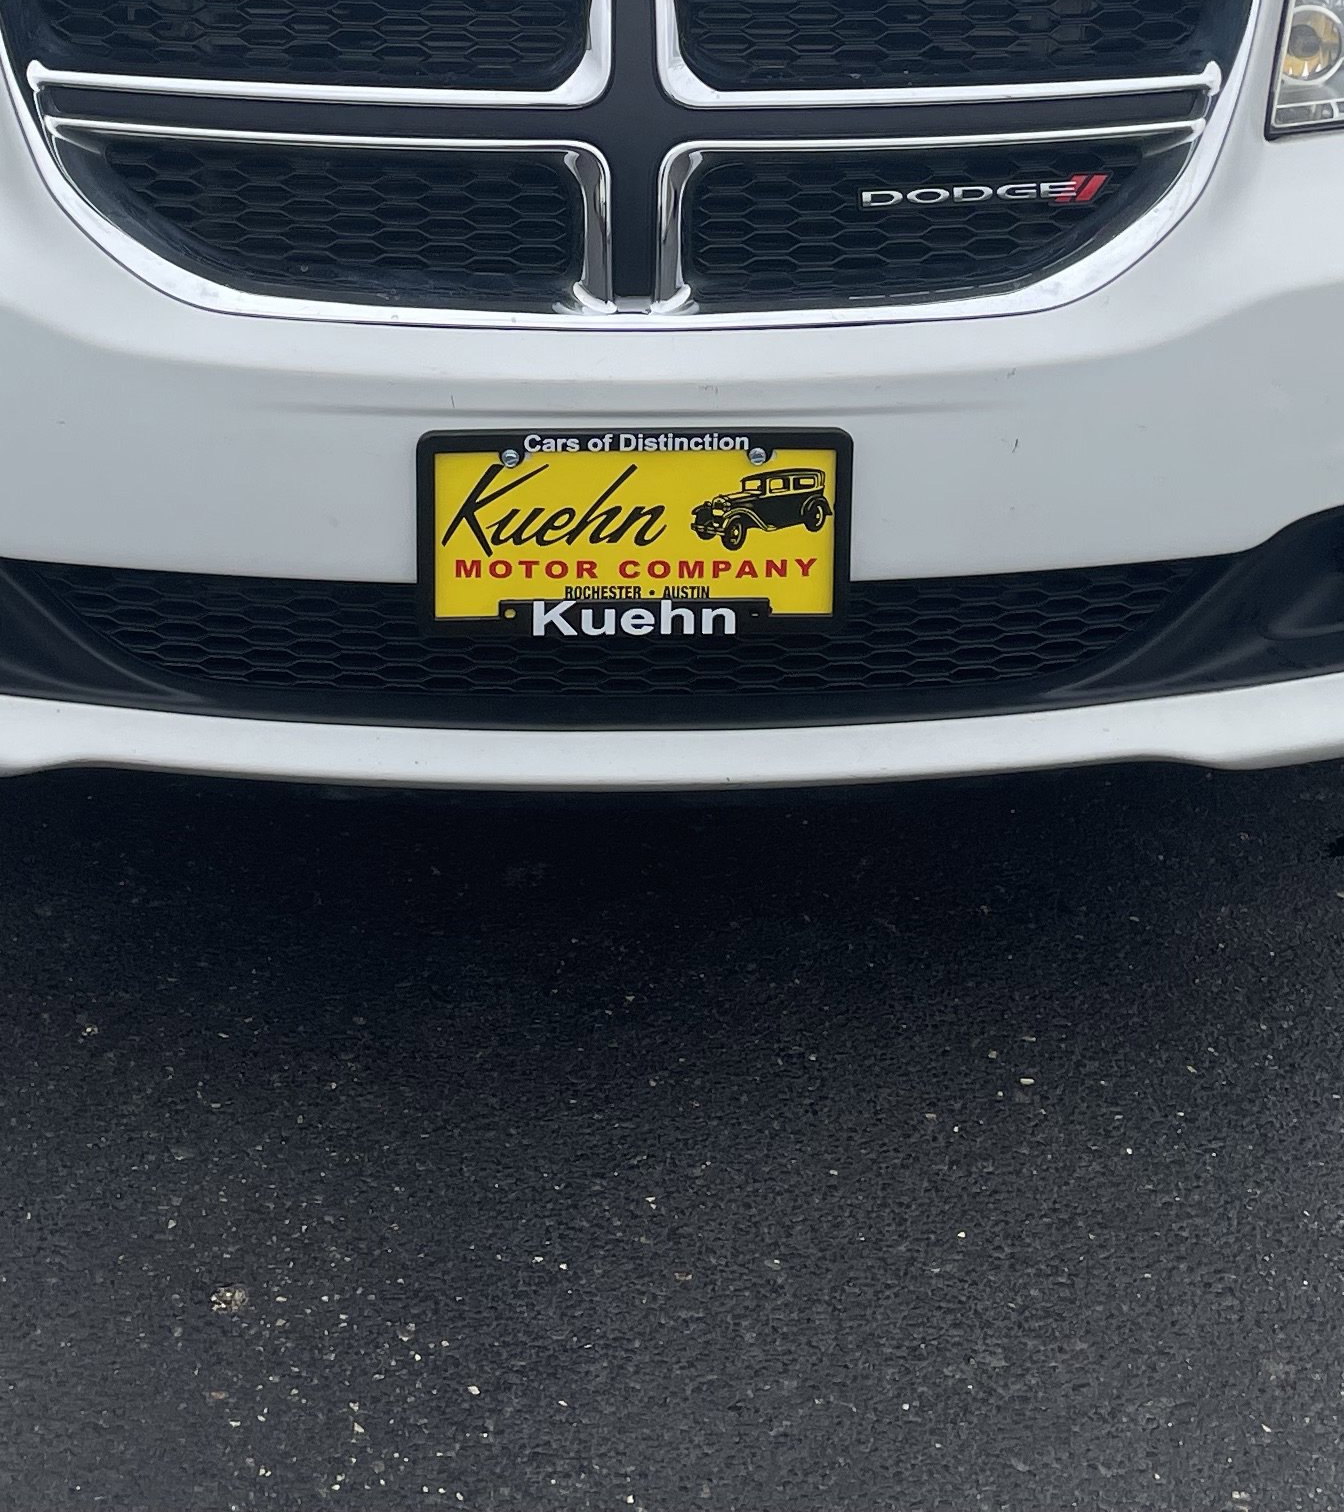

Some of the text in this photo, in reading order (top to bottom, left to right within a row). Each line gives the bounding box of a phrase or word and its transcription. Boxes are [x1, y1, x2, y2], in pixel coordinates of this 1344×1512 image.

[861, 181, 1077, 207] DODGE
[523, 433, 750, 452] Cars of Distinction
[441, 463, 667, 557] Kuehn
[456, 557, 818, 579] MOTOR COMPANY
[564, 585, 710, 600] ROCHESTER AUSTIN
[532, 600, 737, 636] Kuehn
